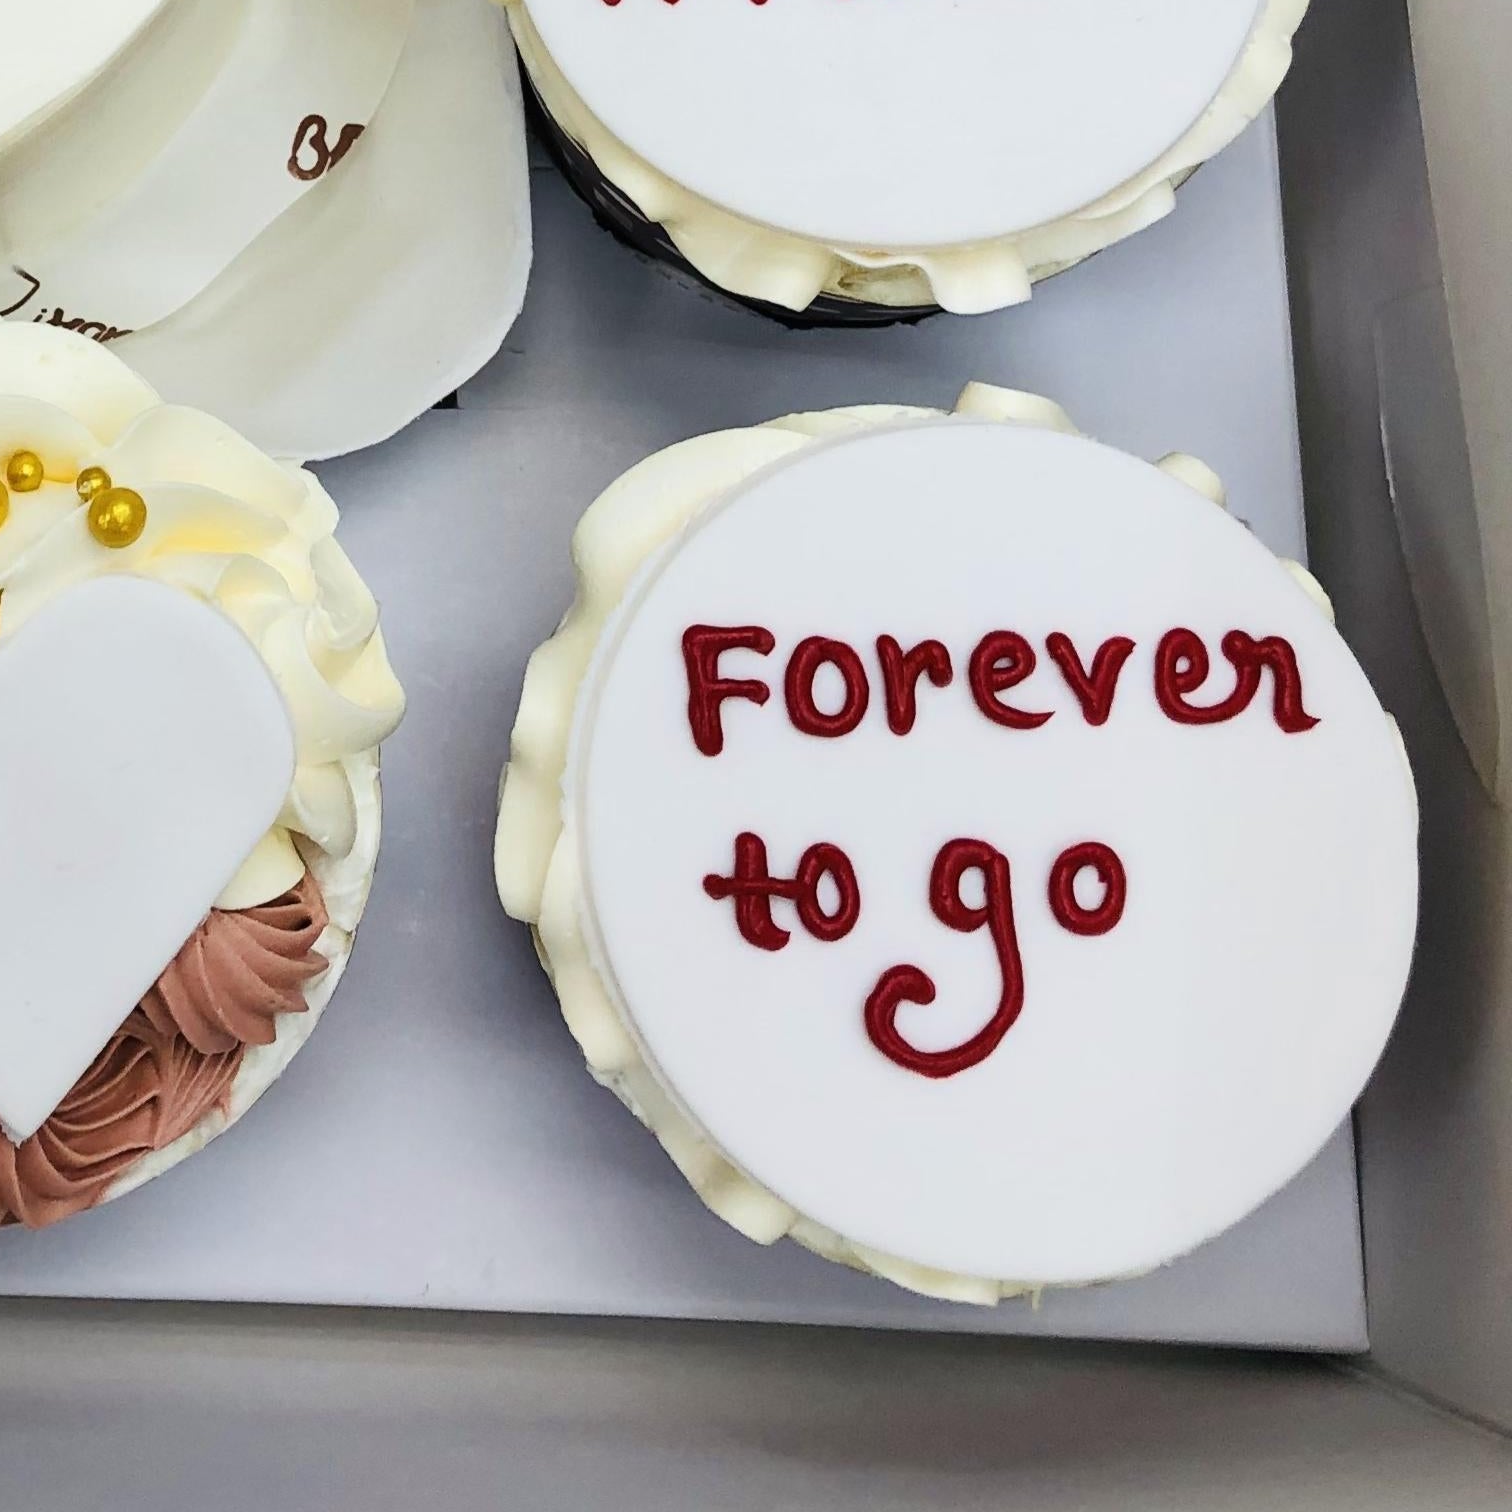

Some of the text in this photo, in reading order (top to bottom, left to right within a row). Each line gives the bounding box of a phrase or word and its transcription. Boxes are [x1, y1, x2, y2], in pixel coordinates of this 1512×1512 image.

[680, 622, 1322, 757] Forever
[701, 831, 1128, 1080] to go
